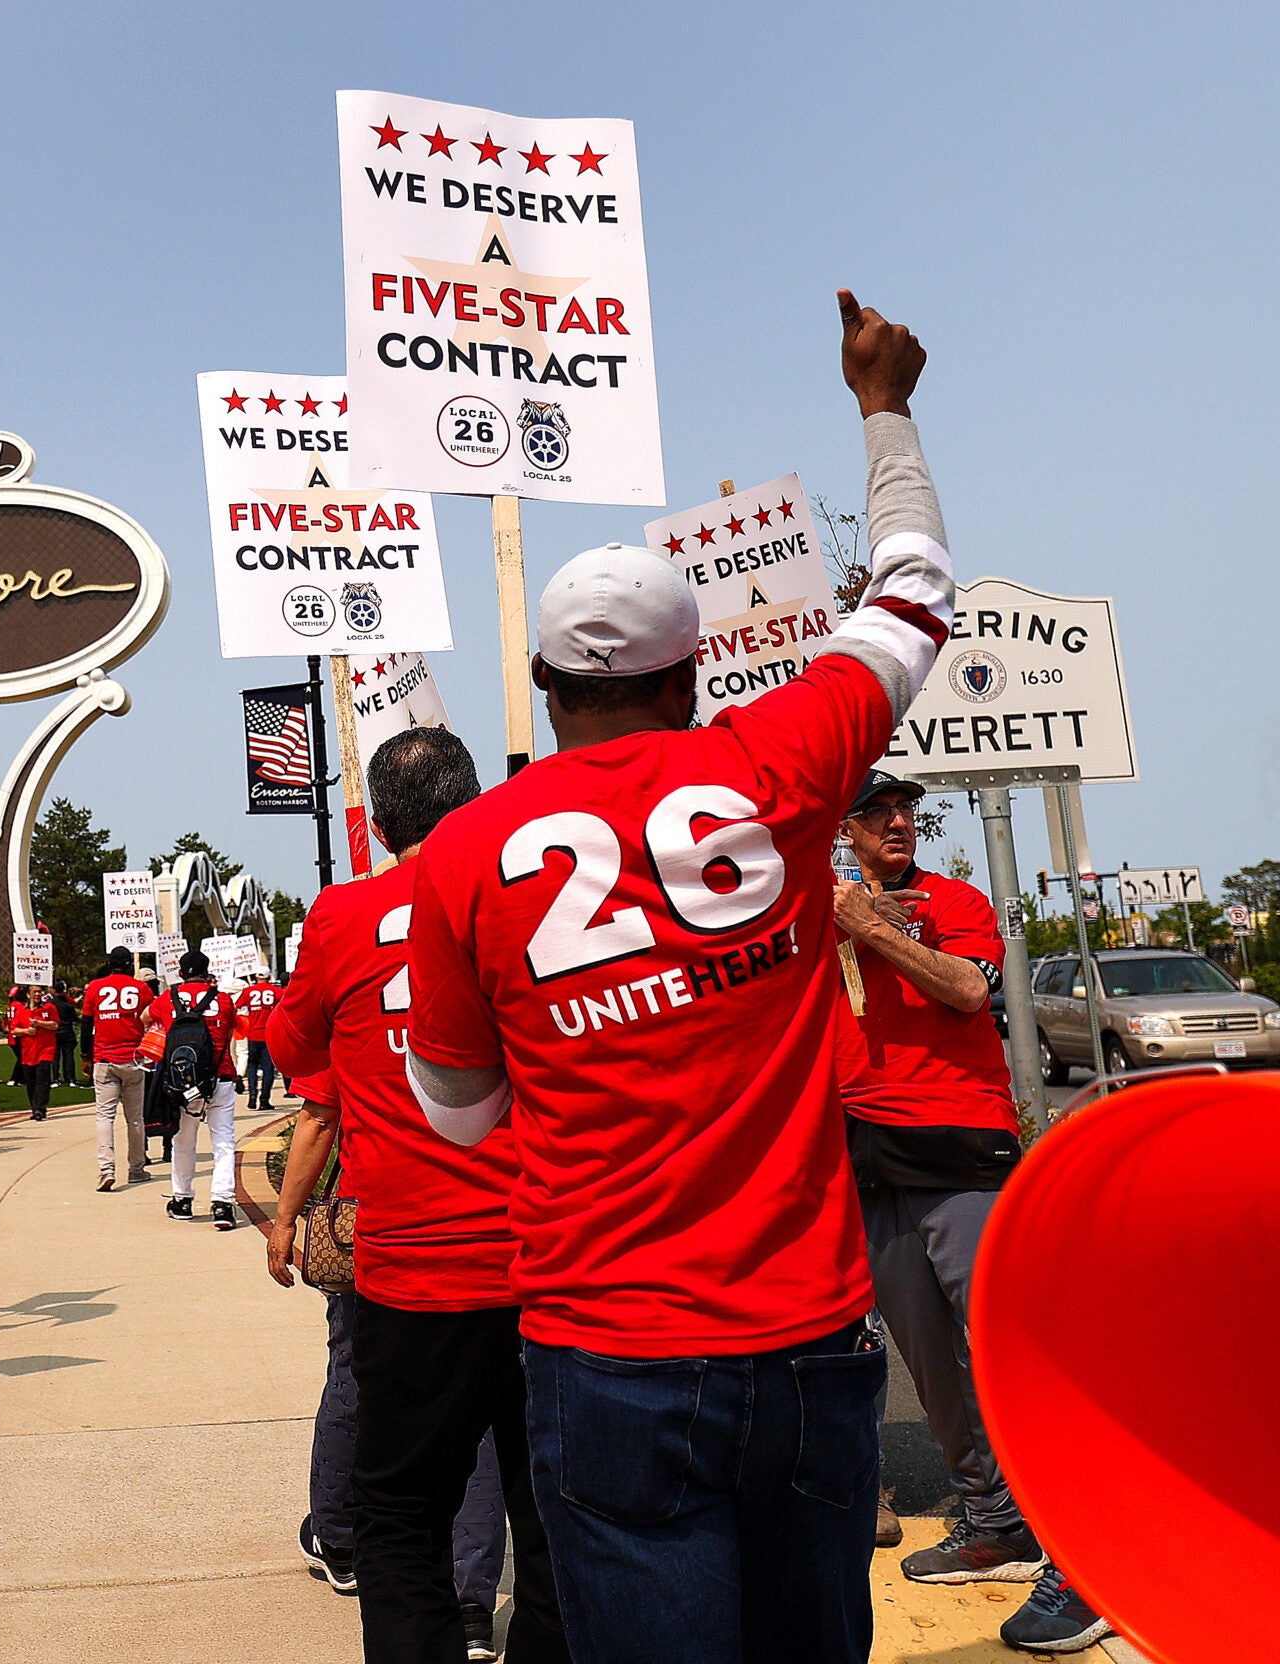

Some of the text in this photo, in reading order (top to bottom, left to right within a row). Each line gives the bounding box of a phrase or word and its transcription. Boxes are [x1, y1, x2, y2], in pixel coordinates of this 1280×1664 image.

[365, 167, 618, 224] WE DESERVE
[482, 234, 511, 266] A
[372, 273, 631, 336] FIVE-STAR
[377, 332, 627, 389] CONTRACT
[449, 408, 497, 419] LOCAL
[219, 427, 348, 452] WE DESE
[455, 419, 494, 442] 26
[451, 445, 499, 454] UNITEHERE!
[308, 466, 330, 488] A
[523, 471, 557, 481] LOCAL
[229, 503, 420, 532] FIVE-STAR
[236, 544, 419, 570] CONTRACT
[714, 532, 809, 579] DESERVE
[750, 585, 768, 609] A
[295, 604, 324, 618] 26
[696, 609, 833, 666] FIVE-STAR
[950, 610, 1088, 653] ERING
[353, 660, 428, 718] WE DESERVE
[1021, 669, 1063, 685] 1630
[409, 709, 417, 727] A
[885, 710, 1088, 757] EVERETT
[251, 782, 312, 798] Encore
[497, 784, 786, 985] 26
[110, 910, 153, 919] FIVE-STAR
[111, 922, 153, 930] CONTRACT
[549, 921, 801, 1037] UNITEHERE!
[98, 986, 139, 1011] 26
[249, 990, 274, 1005] 26
